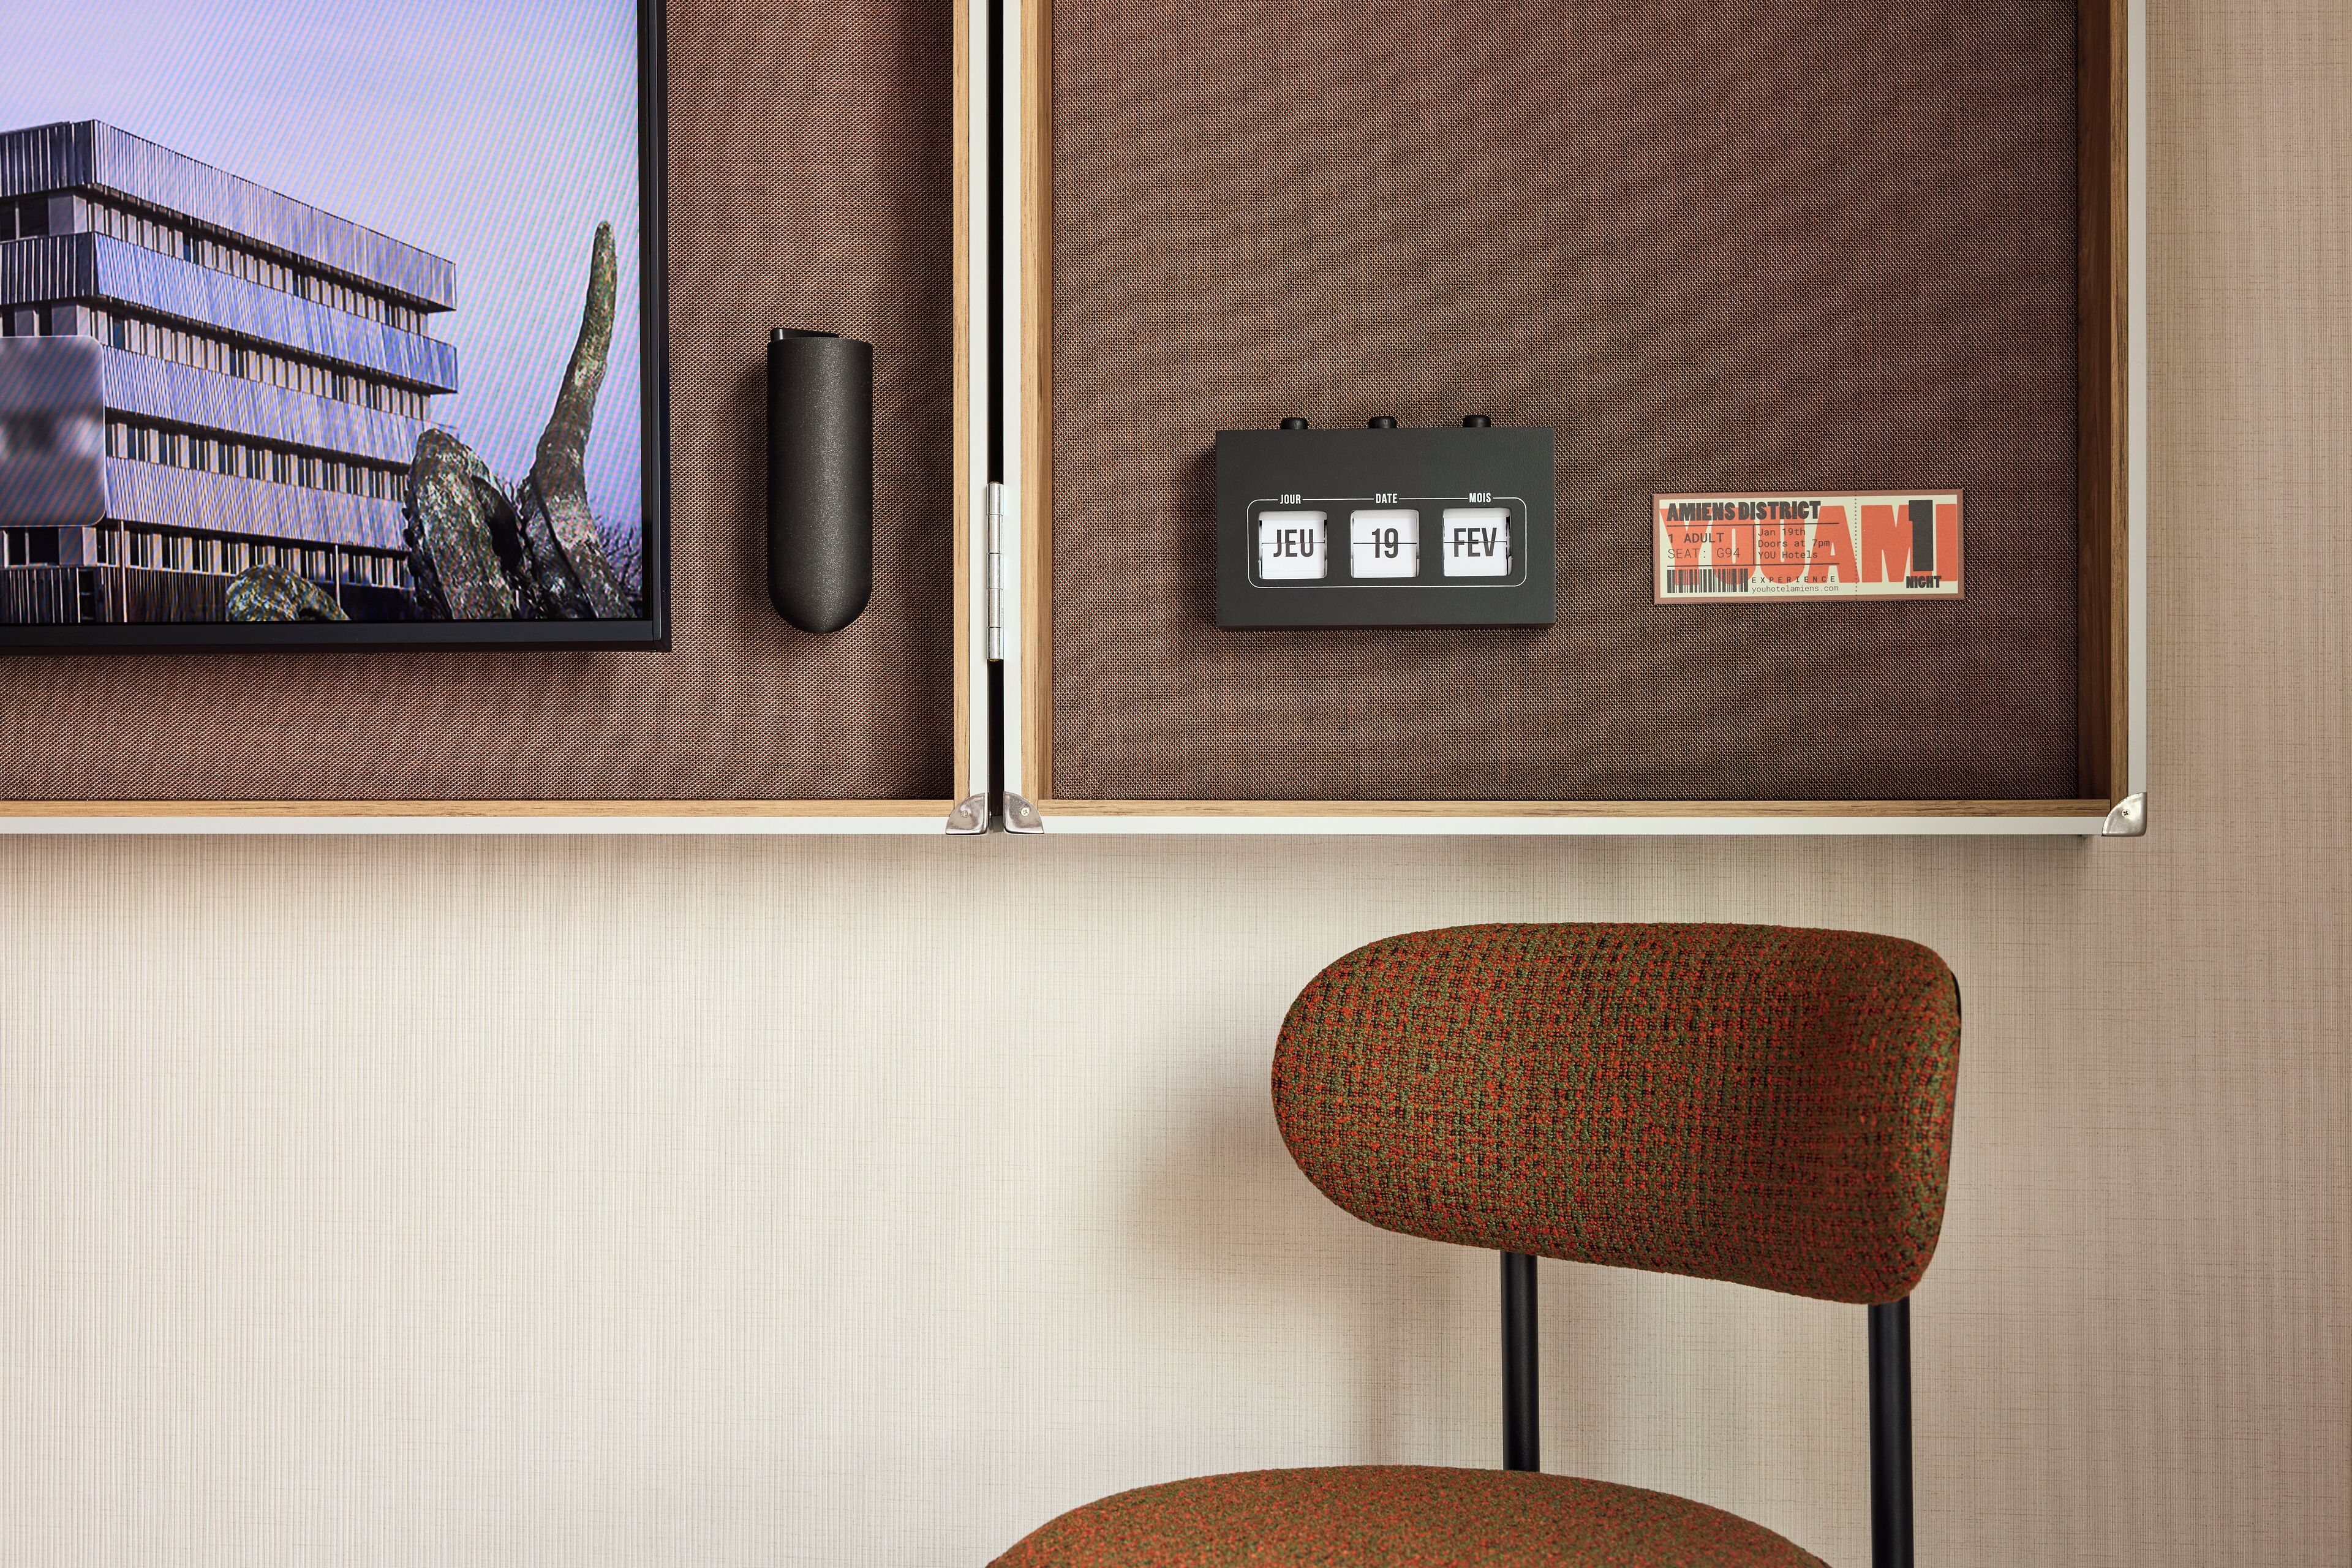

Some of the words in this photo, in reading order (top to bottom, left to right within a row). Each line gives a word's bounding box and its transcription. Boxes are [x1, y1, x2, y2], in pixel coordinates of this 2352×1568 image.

[1280, 494, 1302, 504] JOUR
[1376, 493, 1398, 503] DATE
[1469, 492, 1491, 503] MOIS
[1666, 502, 1736, 521] AMIENS
[1738, 500, 1821, 520] DISTRICT
[1668, 533, 1673, 543] 1
[1684, 532, 1725, 543] ADULT
[1909, 499, 1934, 571] 1
[1273, 529, 1314, 557] JEU
[1371, 528, 1399, 559] 19
[1453, 527, 1498, 557] FEV
[1812, 539, 1830, 548] 7pm
[1716, 548, 1741, 558] G94
[1782, 550, 1818, 559] Hotels
[1905, 575, 1942, 589] NIGHT
[1752, 585, 1839, 594] youhotelamiens.com
